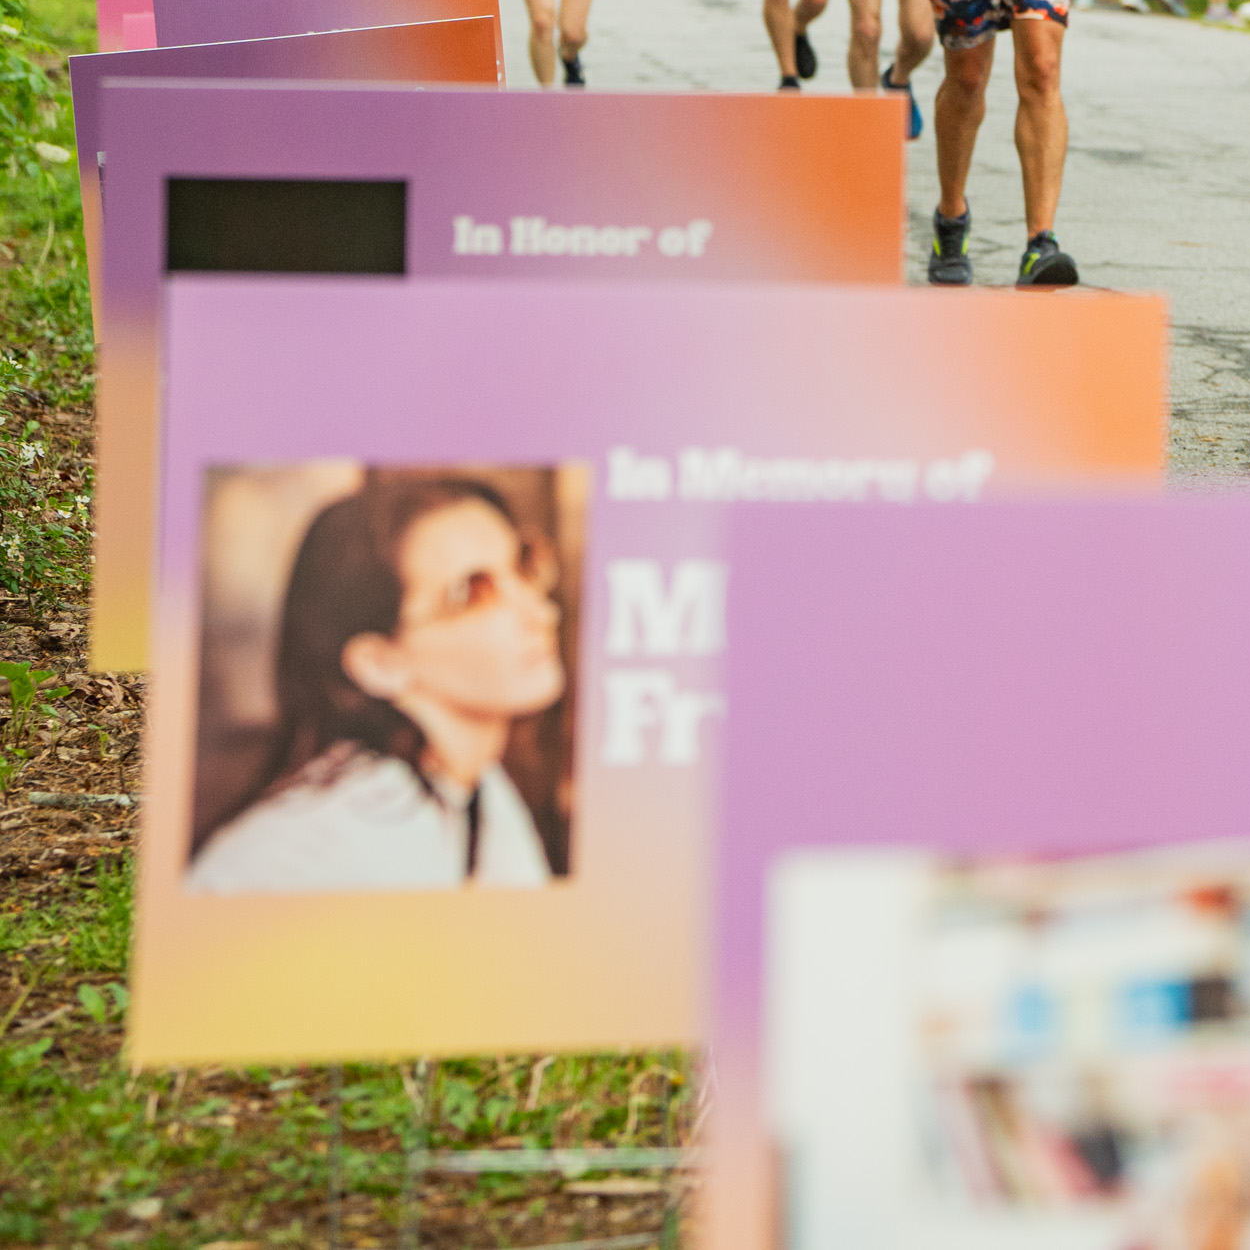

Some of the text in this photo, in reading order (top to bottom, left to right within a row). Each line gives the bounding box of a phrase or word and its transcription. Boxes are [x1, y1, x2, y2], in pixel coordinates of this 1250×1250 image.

[453, 215, 714, 257] In Honor of
[607, 447, 995, 505] In Memory of
